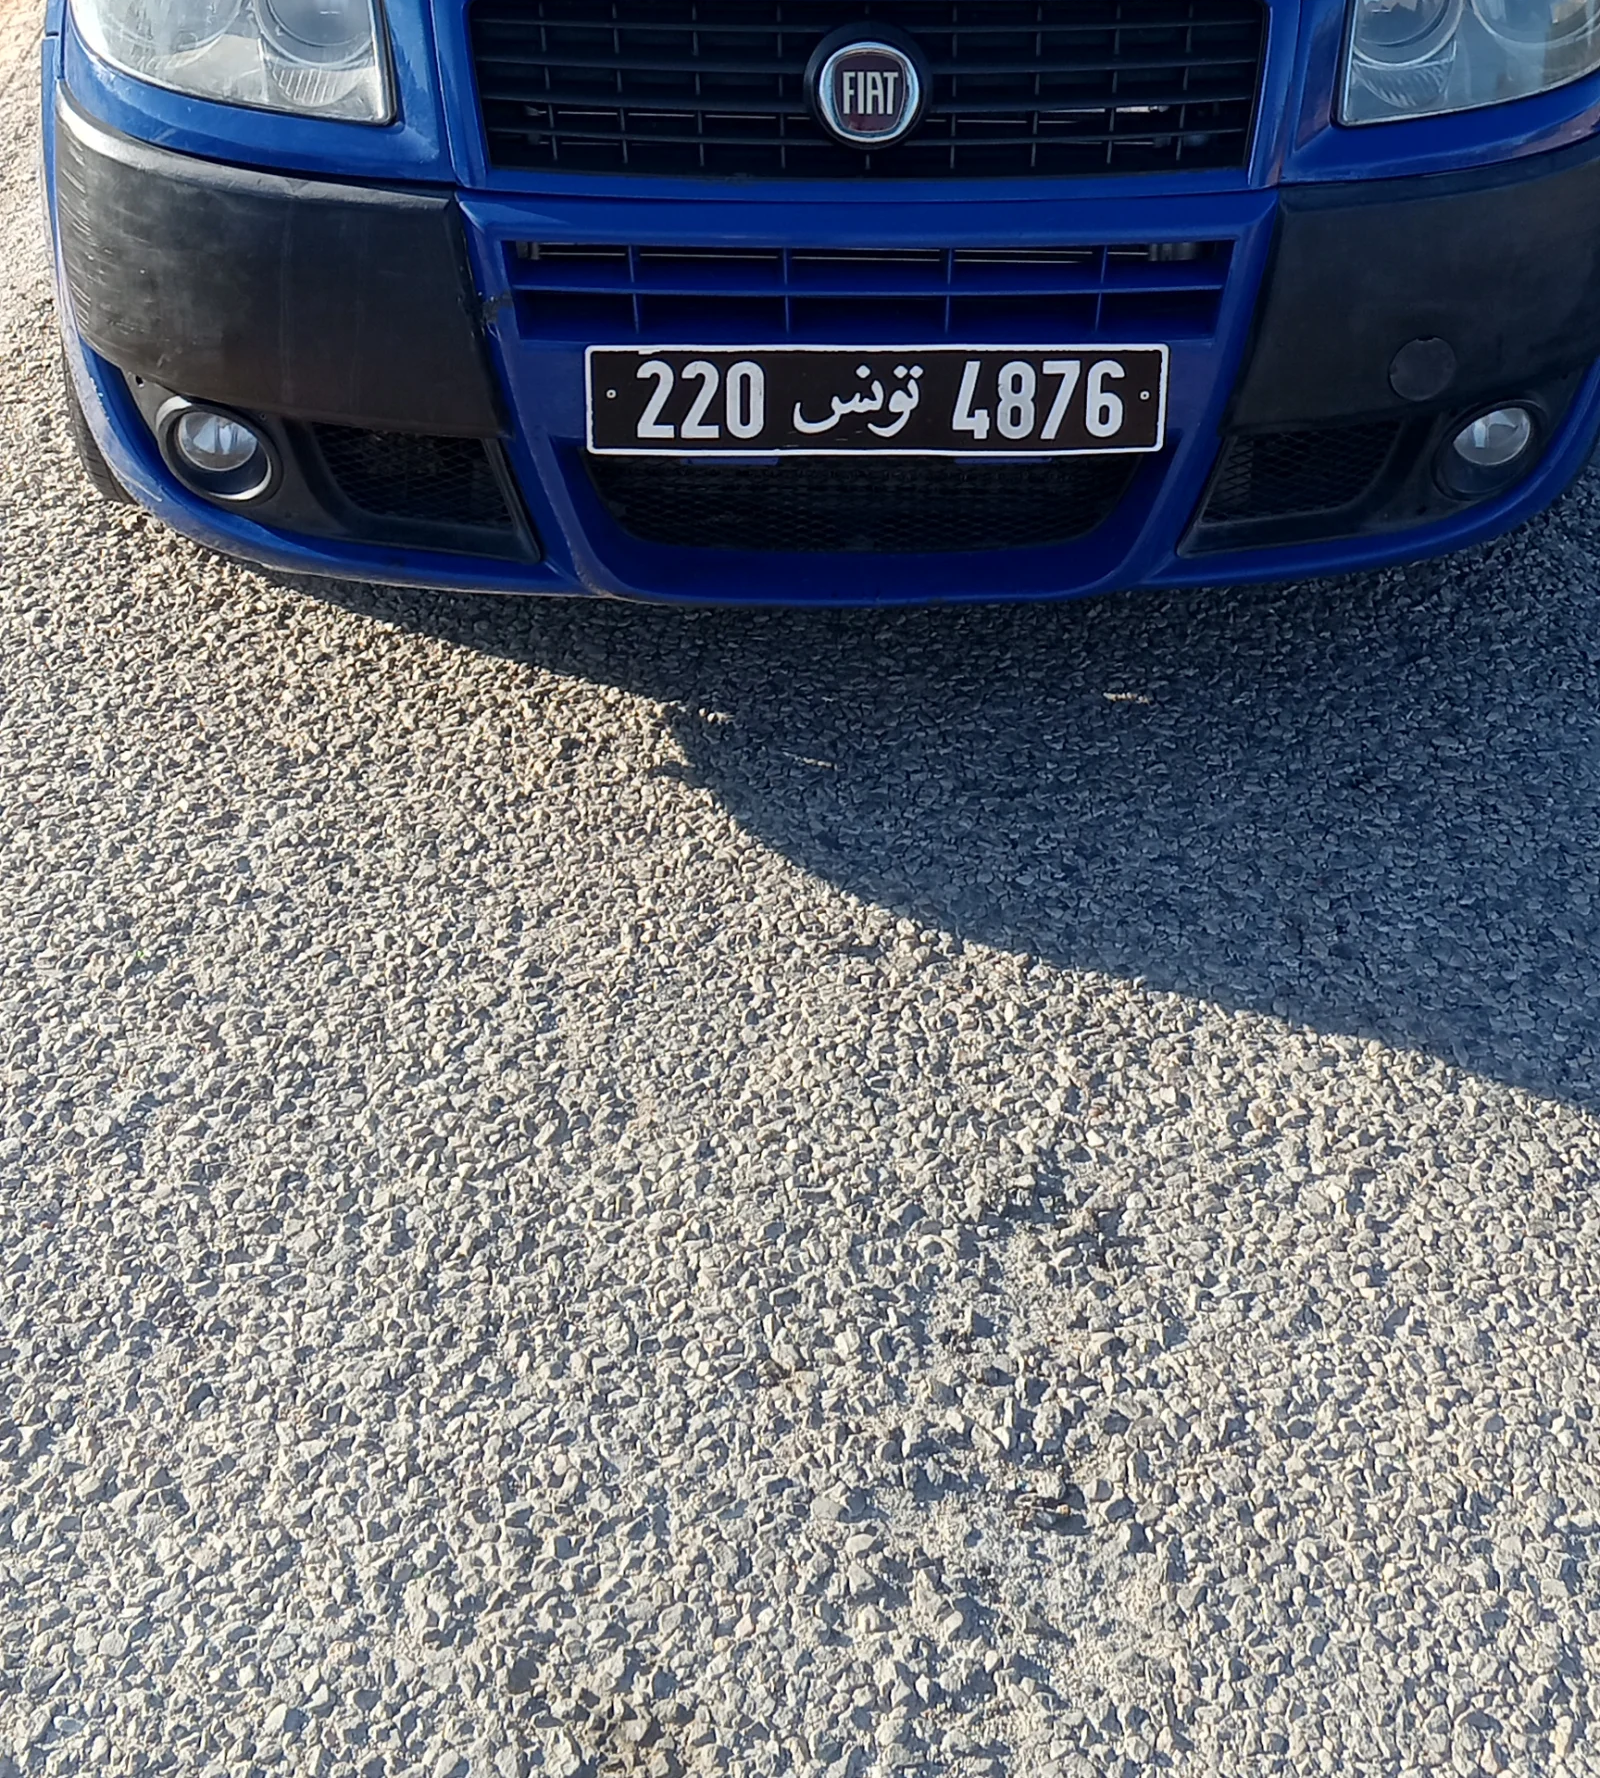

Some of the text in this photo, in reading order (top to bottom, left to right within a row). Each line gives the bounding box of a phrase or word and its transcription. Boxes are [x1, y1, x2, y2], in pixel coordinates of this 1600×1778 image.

[842, 71, 898, 115] FIAT
[635, 359, 1126, 440] 220 تونس 4876
